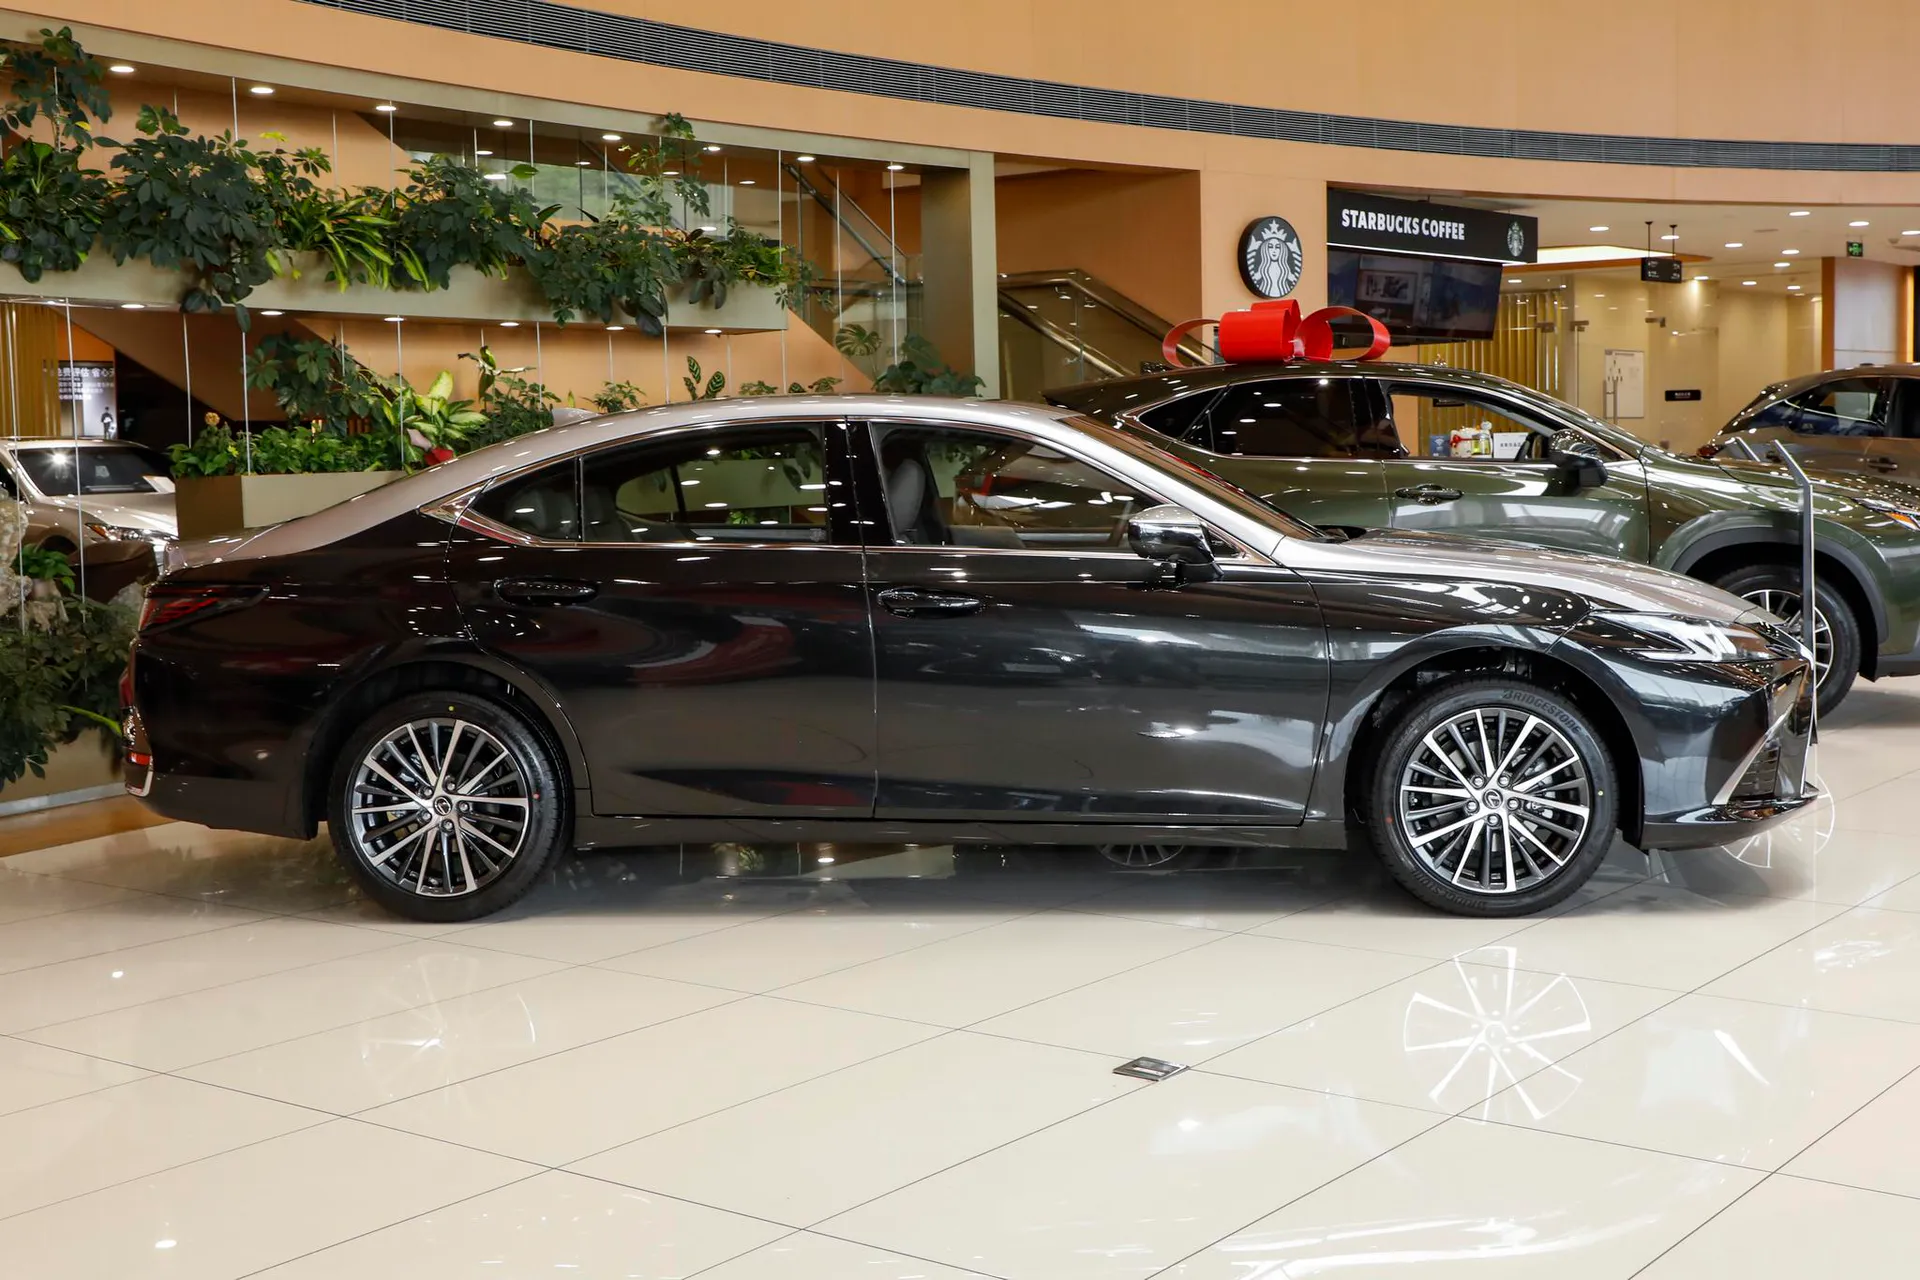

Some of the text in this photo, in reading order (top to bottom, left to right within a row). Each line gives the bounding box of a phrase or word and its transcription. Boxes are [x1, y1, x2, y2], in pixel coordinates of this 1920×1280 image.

[1341, 208, 1465, 240] STARBUCKS COFFEE
[1502, 689, 1582, 734] BRIDGESTONE
